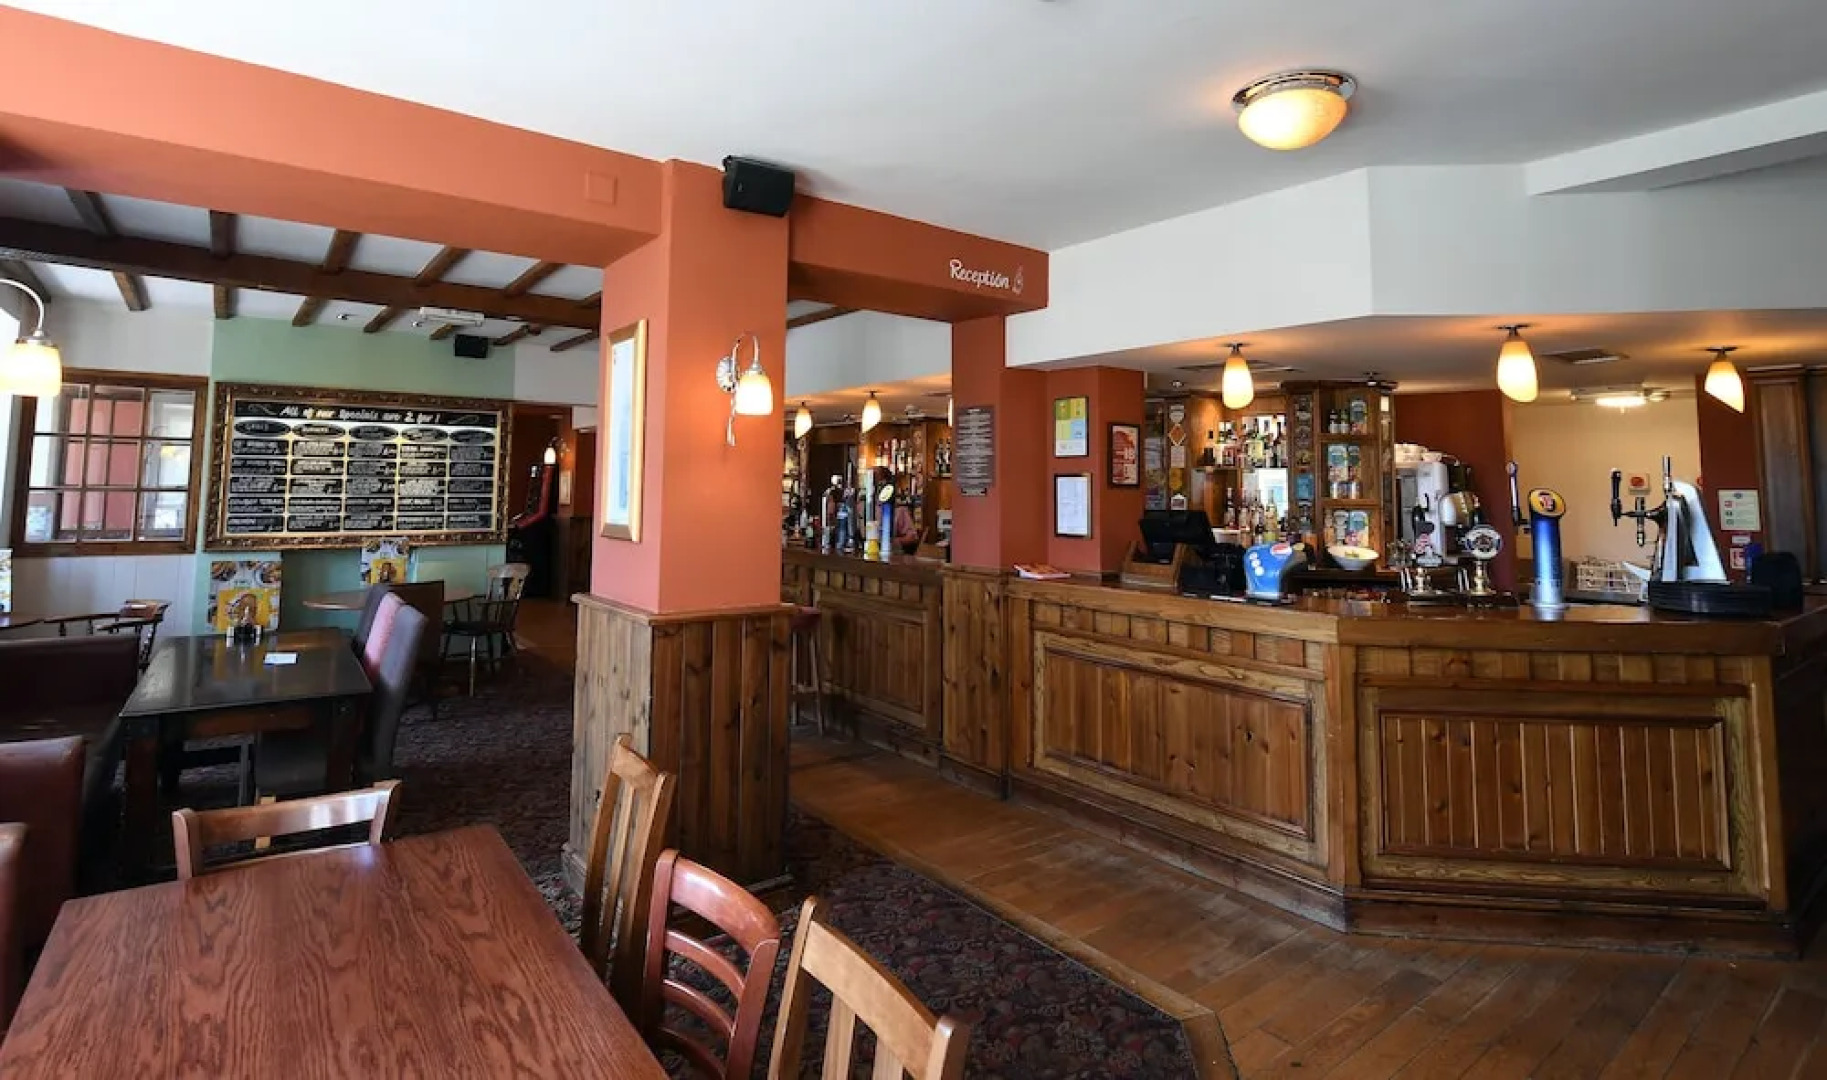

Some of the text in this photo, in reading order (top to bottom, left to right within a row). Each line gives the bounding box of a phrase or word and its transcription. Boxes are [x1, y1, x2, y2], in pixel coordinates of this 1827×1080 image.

[950, 259, 1009, 289] Reception
[279, 405, 299, 417] All
[303, 407, 314, 420] of
[316, 408, 336, 418] our
[382, 411, 402, 421] are
[404, 411, 415, 423] 2
[417, 412, 434, 424] for
